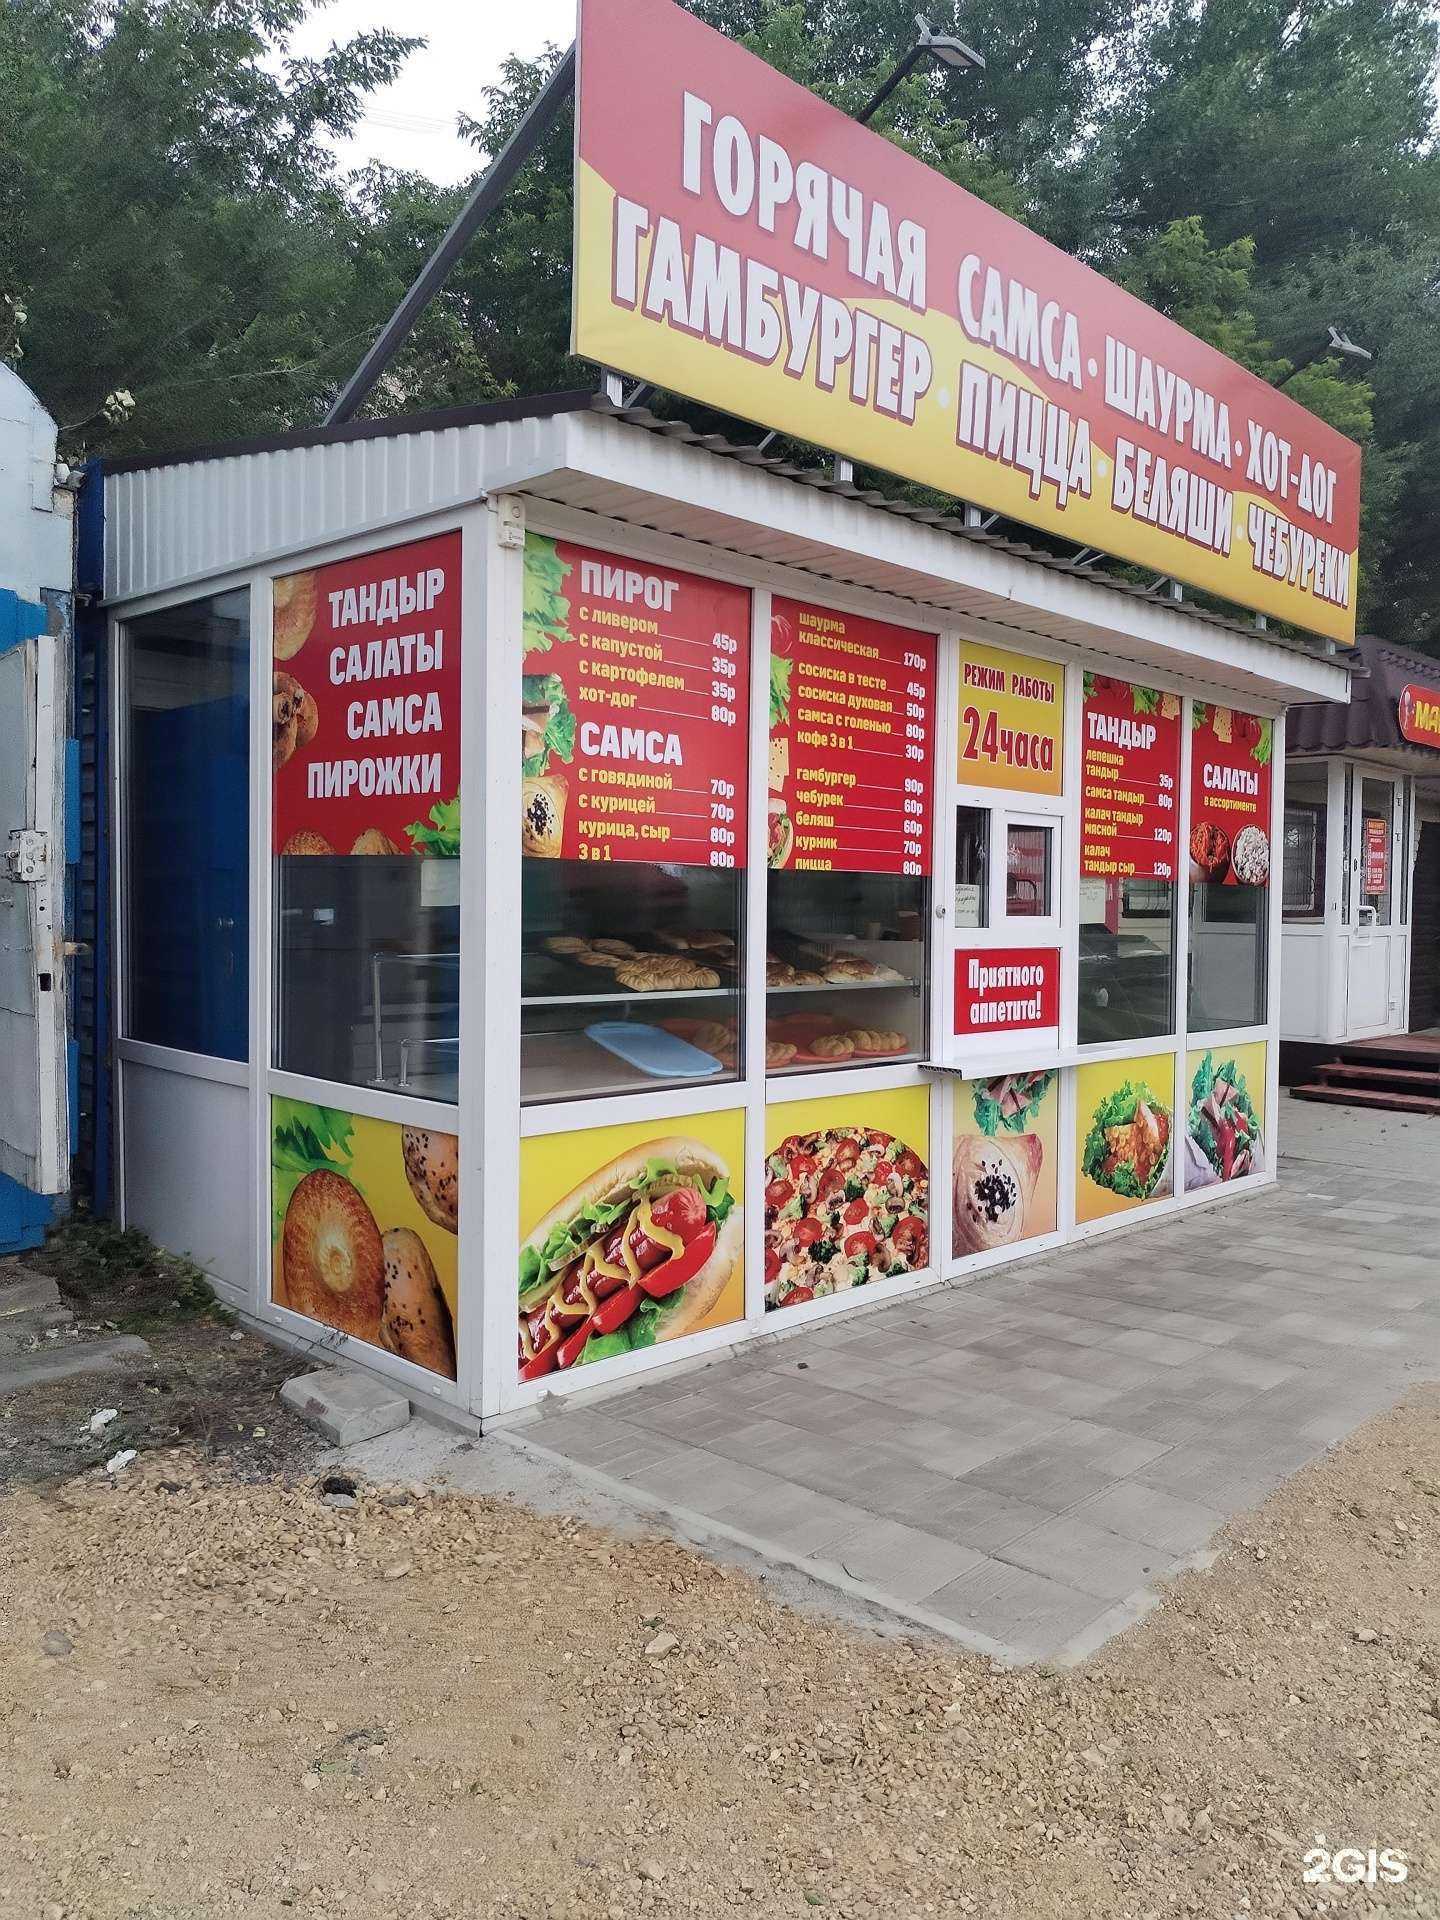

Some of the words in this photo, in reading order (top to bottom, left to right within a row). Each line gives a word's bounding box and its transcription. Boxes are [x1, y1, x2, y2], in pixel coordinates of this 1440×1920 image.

[683, 90, 927, 314] ГОРЯЧАЯ
[957, 254, 1083, 390] САМСА
[1105, 335, 1232, 470] ШАУРМА
[1245, 419, 1337, 524] ХОТ-ДОГ
[612, 195, 933, 425] ГАМБУРГЕР
[956, 360, 1092, 511] ПИЦЦА
[1111, 437, 1233, 556] БЕЛЯШИ
[1248, 502, 1351, 609] ЧЕБУРЕКИ
[328, 568, 445, 628] ТАНДЫР
[581, 560, 679, 613] ПИРОГ
[580, 607, 588, 620] с
[592, 608, 659, 635] ливером
[712, 633, 737, 654] 45р
[799, 613, 845, 634] шаурма
[330, 630, 443, 685] САЛАТЫ
[580, 633, 588, 647] с
[592, 636, 662, 661] капустой
[712, 657, 736, 677] 35р
[799, 631, 880, 659] классическая
[903, 652, 927, 671] 170р
[579, 660, 588, 674] с
[592, 662, 685, 690] картофелем
[712, 681, 736, 701] 35р
[798, 662, 846, 683] сосиска
[848, 673, 855, 684] в
[857, 673, 887, 690] тесте
[907, 682, 925, 700] 45р
[964, 662, 1005, 693] РЕЖИМ
[1011, 673, 1055, 704] РАБОТЫ
[347, 692, 442, 740] САМСА
[579, 686, 638, 708] хот-дог
[711, 705, 736, 726] 80р
[798, 685, 846, 703] сосиска
[848, 695, 893, 713] духовая
[906, 703, 924, 720] 50р
[1414, 699, 1440, 734] МА
[797, 708, 834, 725] самса
[836, 715, 842, 727] с
[844, 717, 892, 735] голенью
[1087, 712, 1157, 750] ТАНДЫР
[580, 722, 683, 766] САМСА
[797, 731, 828, 748] кофе
[830, 733, 837, 745] 3
[839, 738, 846, 749] в
[847, 735, 853, 750] 1
[905, 744, 924, 762] 30р
[1086, 749, 1124, 766] лепешка
[308, 753, 442, 798] ПИРОЖКИ
[579, 768, 587, 782] с
[591, 769, 673, 790] говядиной
[710, 779, 735, 799] 70р
[796, 767, 857, 788] гамбургер
[904, 778, 924, 795] 90р
[1086, 764, 1119, 783] тандыр
[1159, 774, 1173, 789] 35р
[1203, 763, 1259, 796] САЛАТЫ
[579, 794, 587, 808] с
[591, 795, 656, 816] курицей
[710, 804, 735, 823] 70р
[796, 789, 843, 807] чебурек
[904, 799, 923, 816] 60р
[1085, 785, 1112, 800] самса
[1113, 789, 1145, 806] тандыр
[1204, 796, 1209, 806] в
[1210, 797, 1257, 813] ассортименте
[579, 820, 639, 841] курица,
[641, 824, 671, 842] сыр
[710, 827, 735, 846] 80р
[796, 811, 834, 828] беляш
[903, 820, 923, 837] 60р
[1085, 807, 1111, 822] калач
[1112, 810, 1144, 826] тандыр
[795, 835, 838, 850] курник
[903, 840, 922, 857] 70р
[1085, 822, 1117, 837] мясной
[1154, 828, 1172, 845] 120р
[579, 843, 588, 860] 3
[591, 847, 600, 860] в
[603, 845, 611, 861] 1
[710, 851, 735, 868] 80р
[1084, 844, 1110, 857] калач
[1084, 859, 1118, 875] тандыр
[1119, 861, 1135, 875] сыр
[1153, 861, 1171, 878] 120р
[968, 958, 1044, 996] Приятного
[970, 991, 1042, 1025] аппетита!
